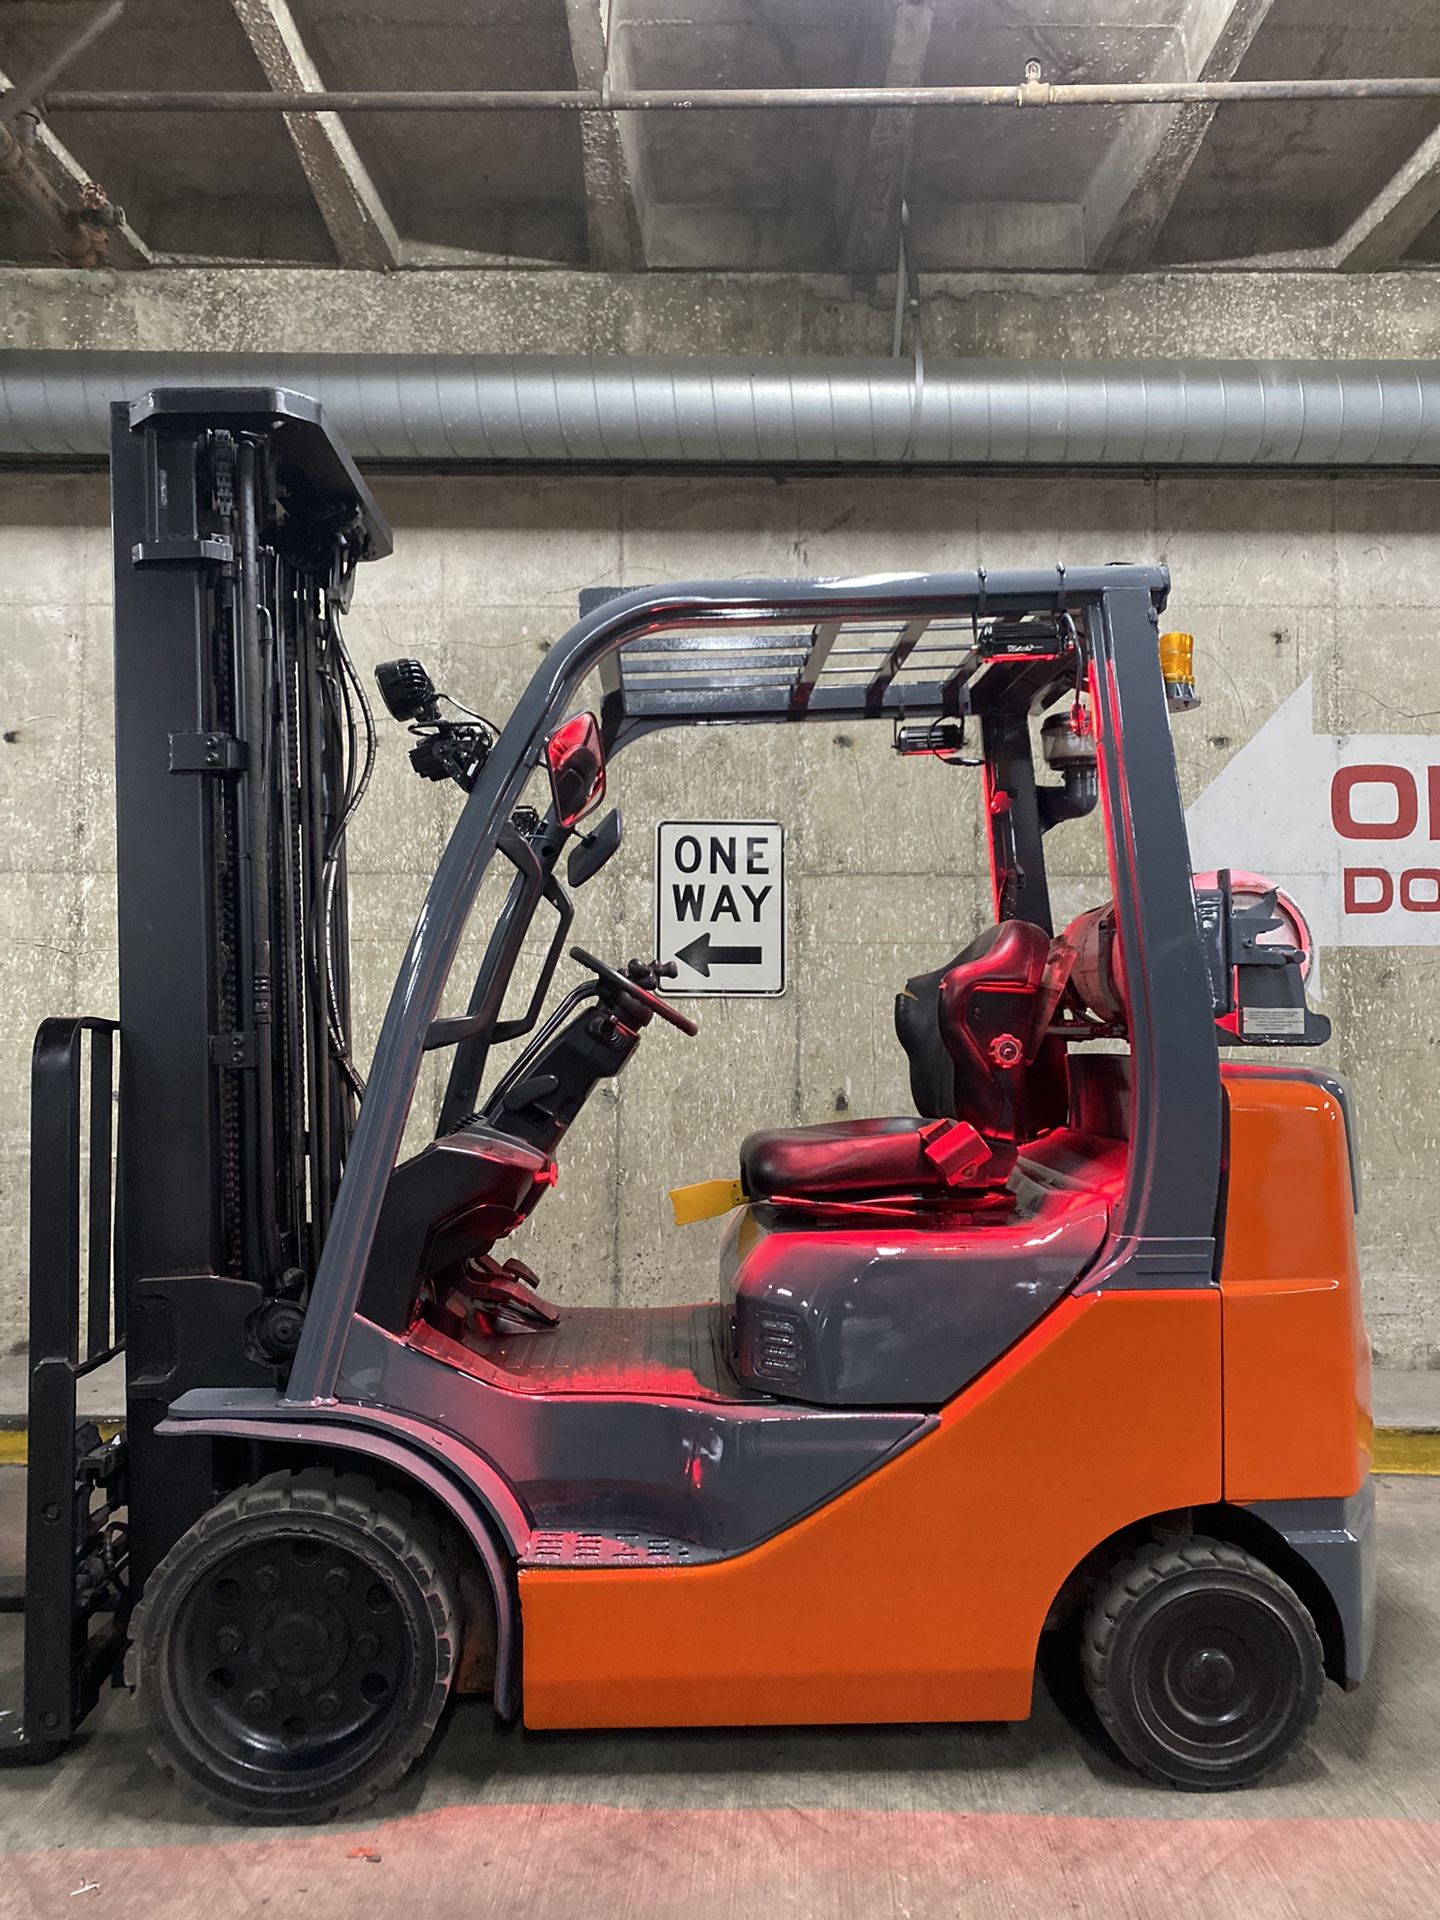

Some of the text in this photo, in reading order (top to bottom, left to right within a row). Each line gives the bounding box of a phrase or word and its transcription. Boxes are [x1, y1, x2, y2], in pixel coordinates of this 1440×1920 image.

[1331, 764, 1440, 841] O
[674, 835, 770, 875] ONE
[672, 883, 773, 922] WAY
